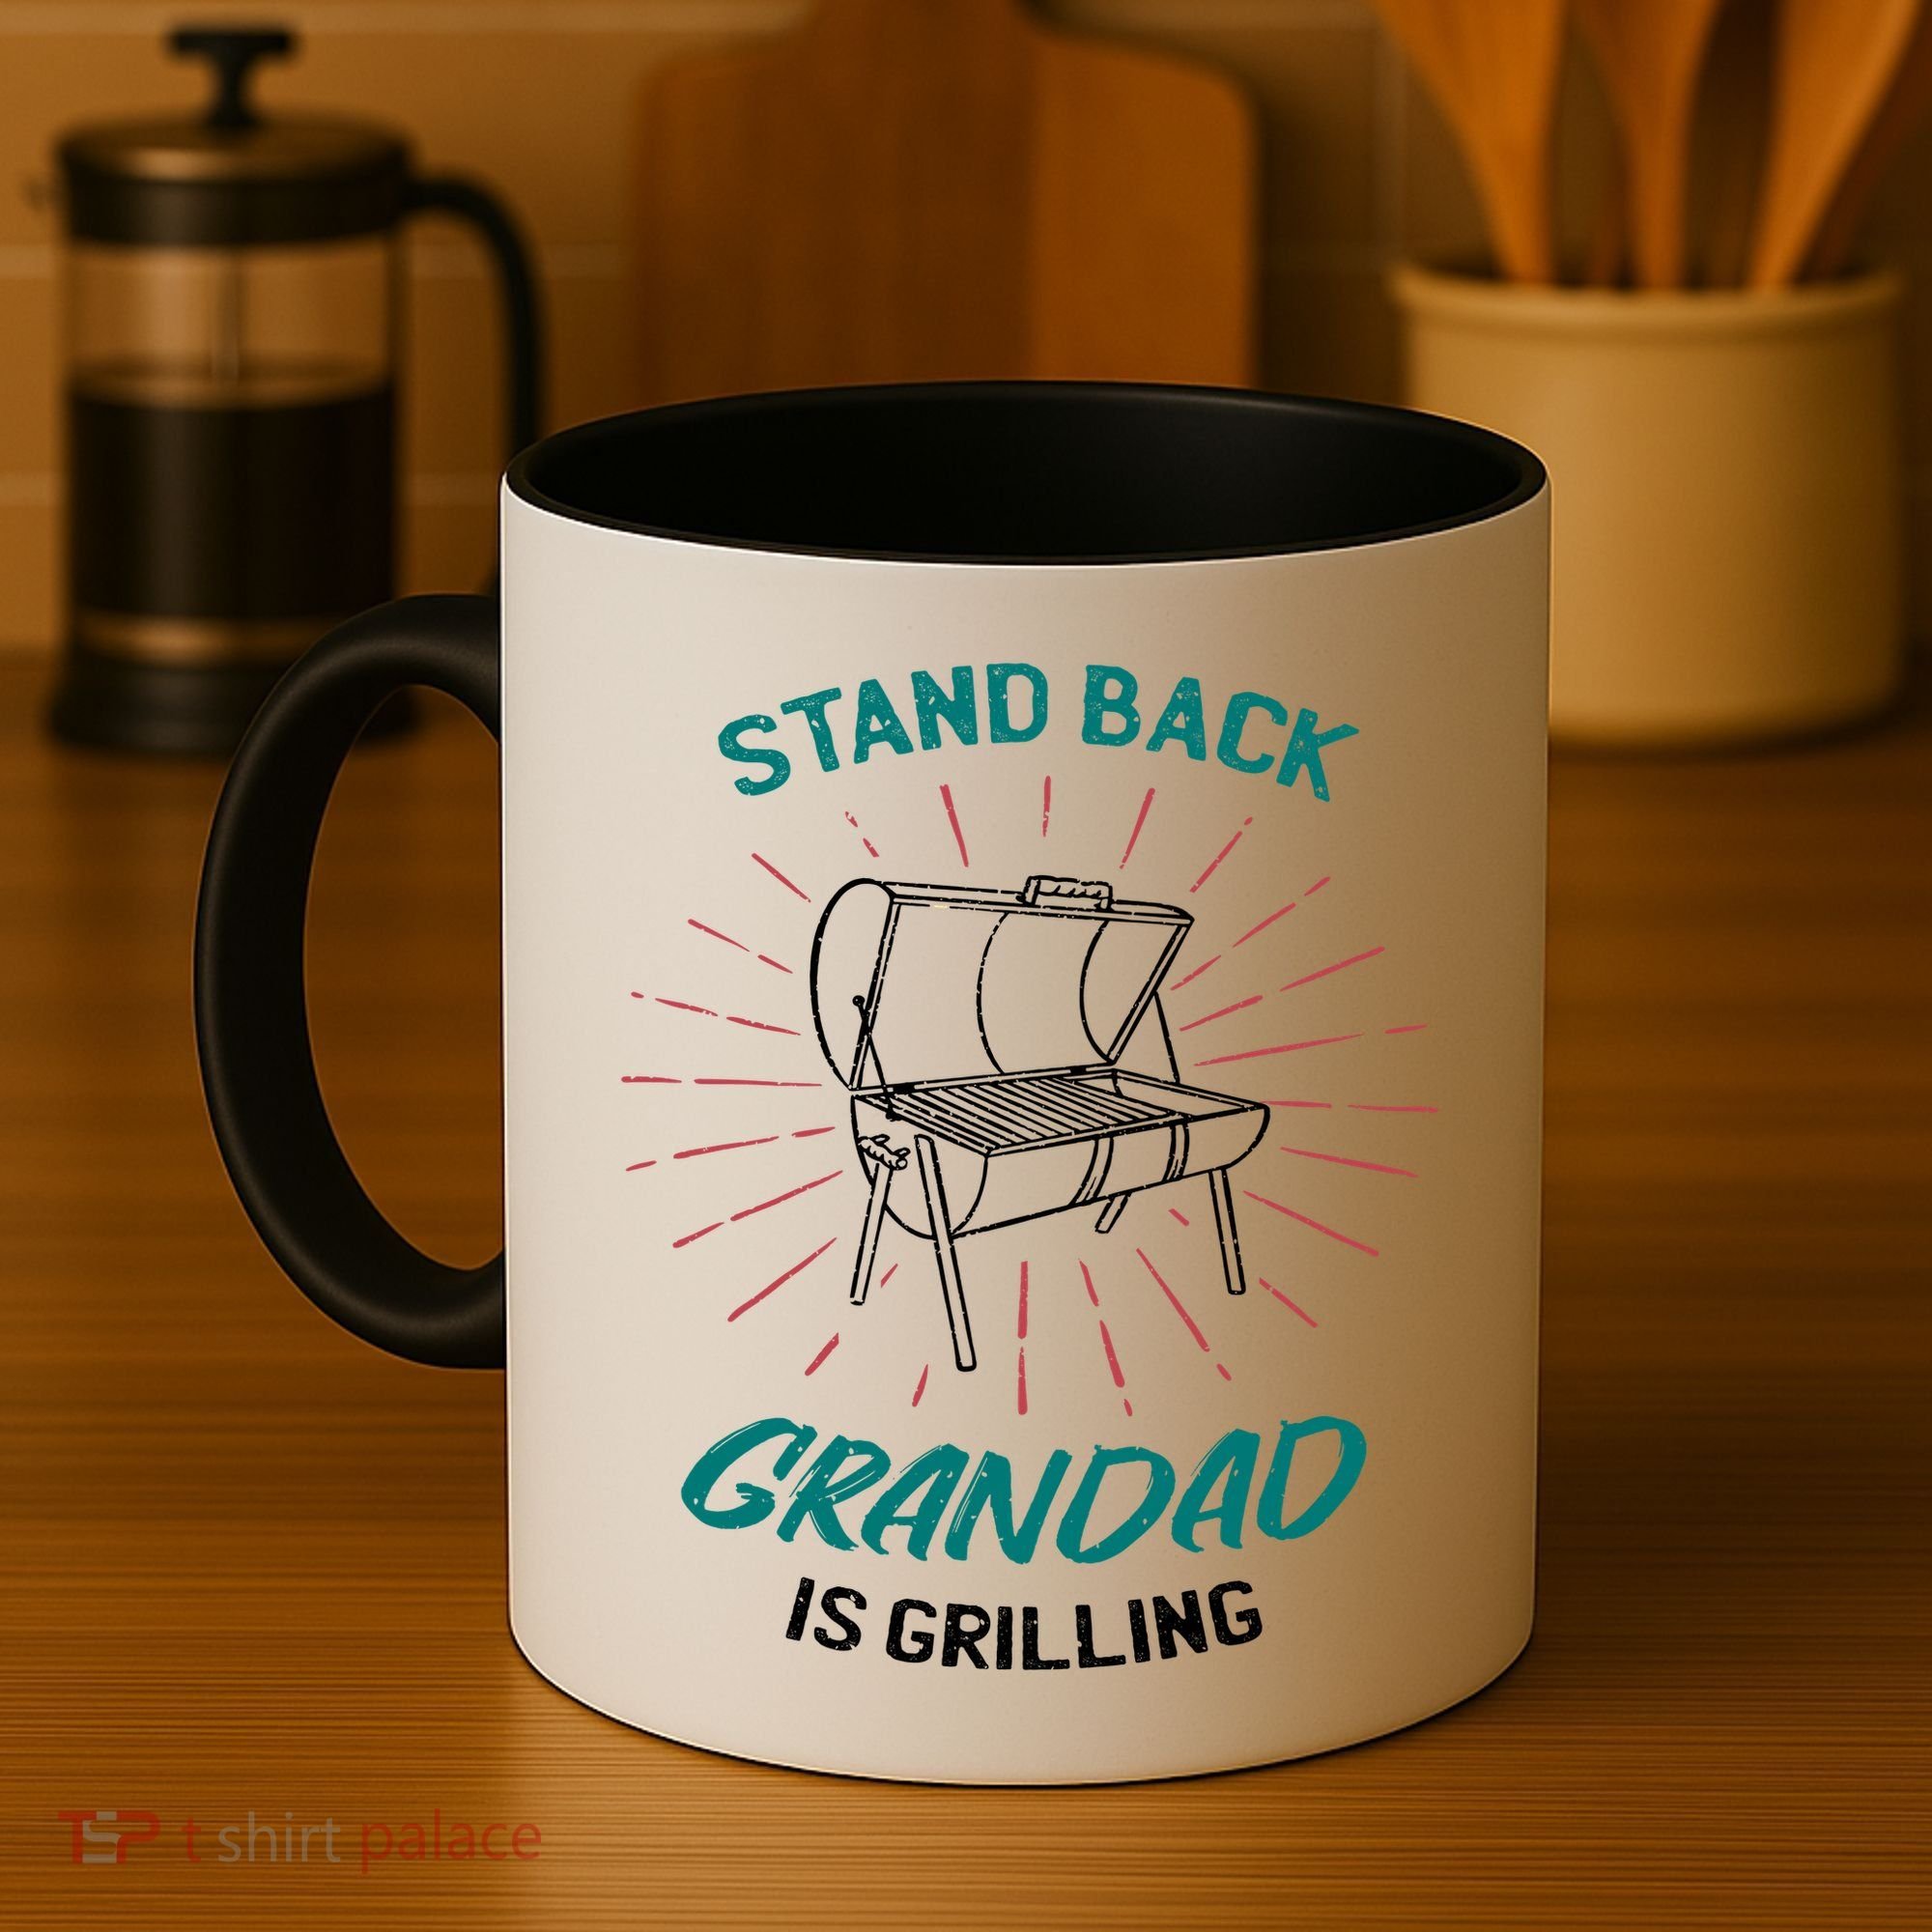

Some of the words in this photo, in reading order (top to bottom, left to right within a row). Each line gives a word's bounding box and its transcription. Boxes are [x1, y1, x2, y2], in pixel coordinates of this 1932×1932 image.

[718, 663, 1049, 796] STAND
[1081, 664, 1359, 803] BACK
[680, 1415, 1367, 1565] GRANDAD
[785, 1577, 867, 1652] IS
[885, 1579, 1264, 1671] GRILLING
